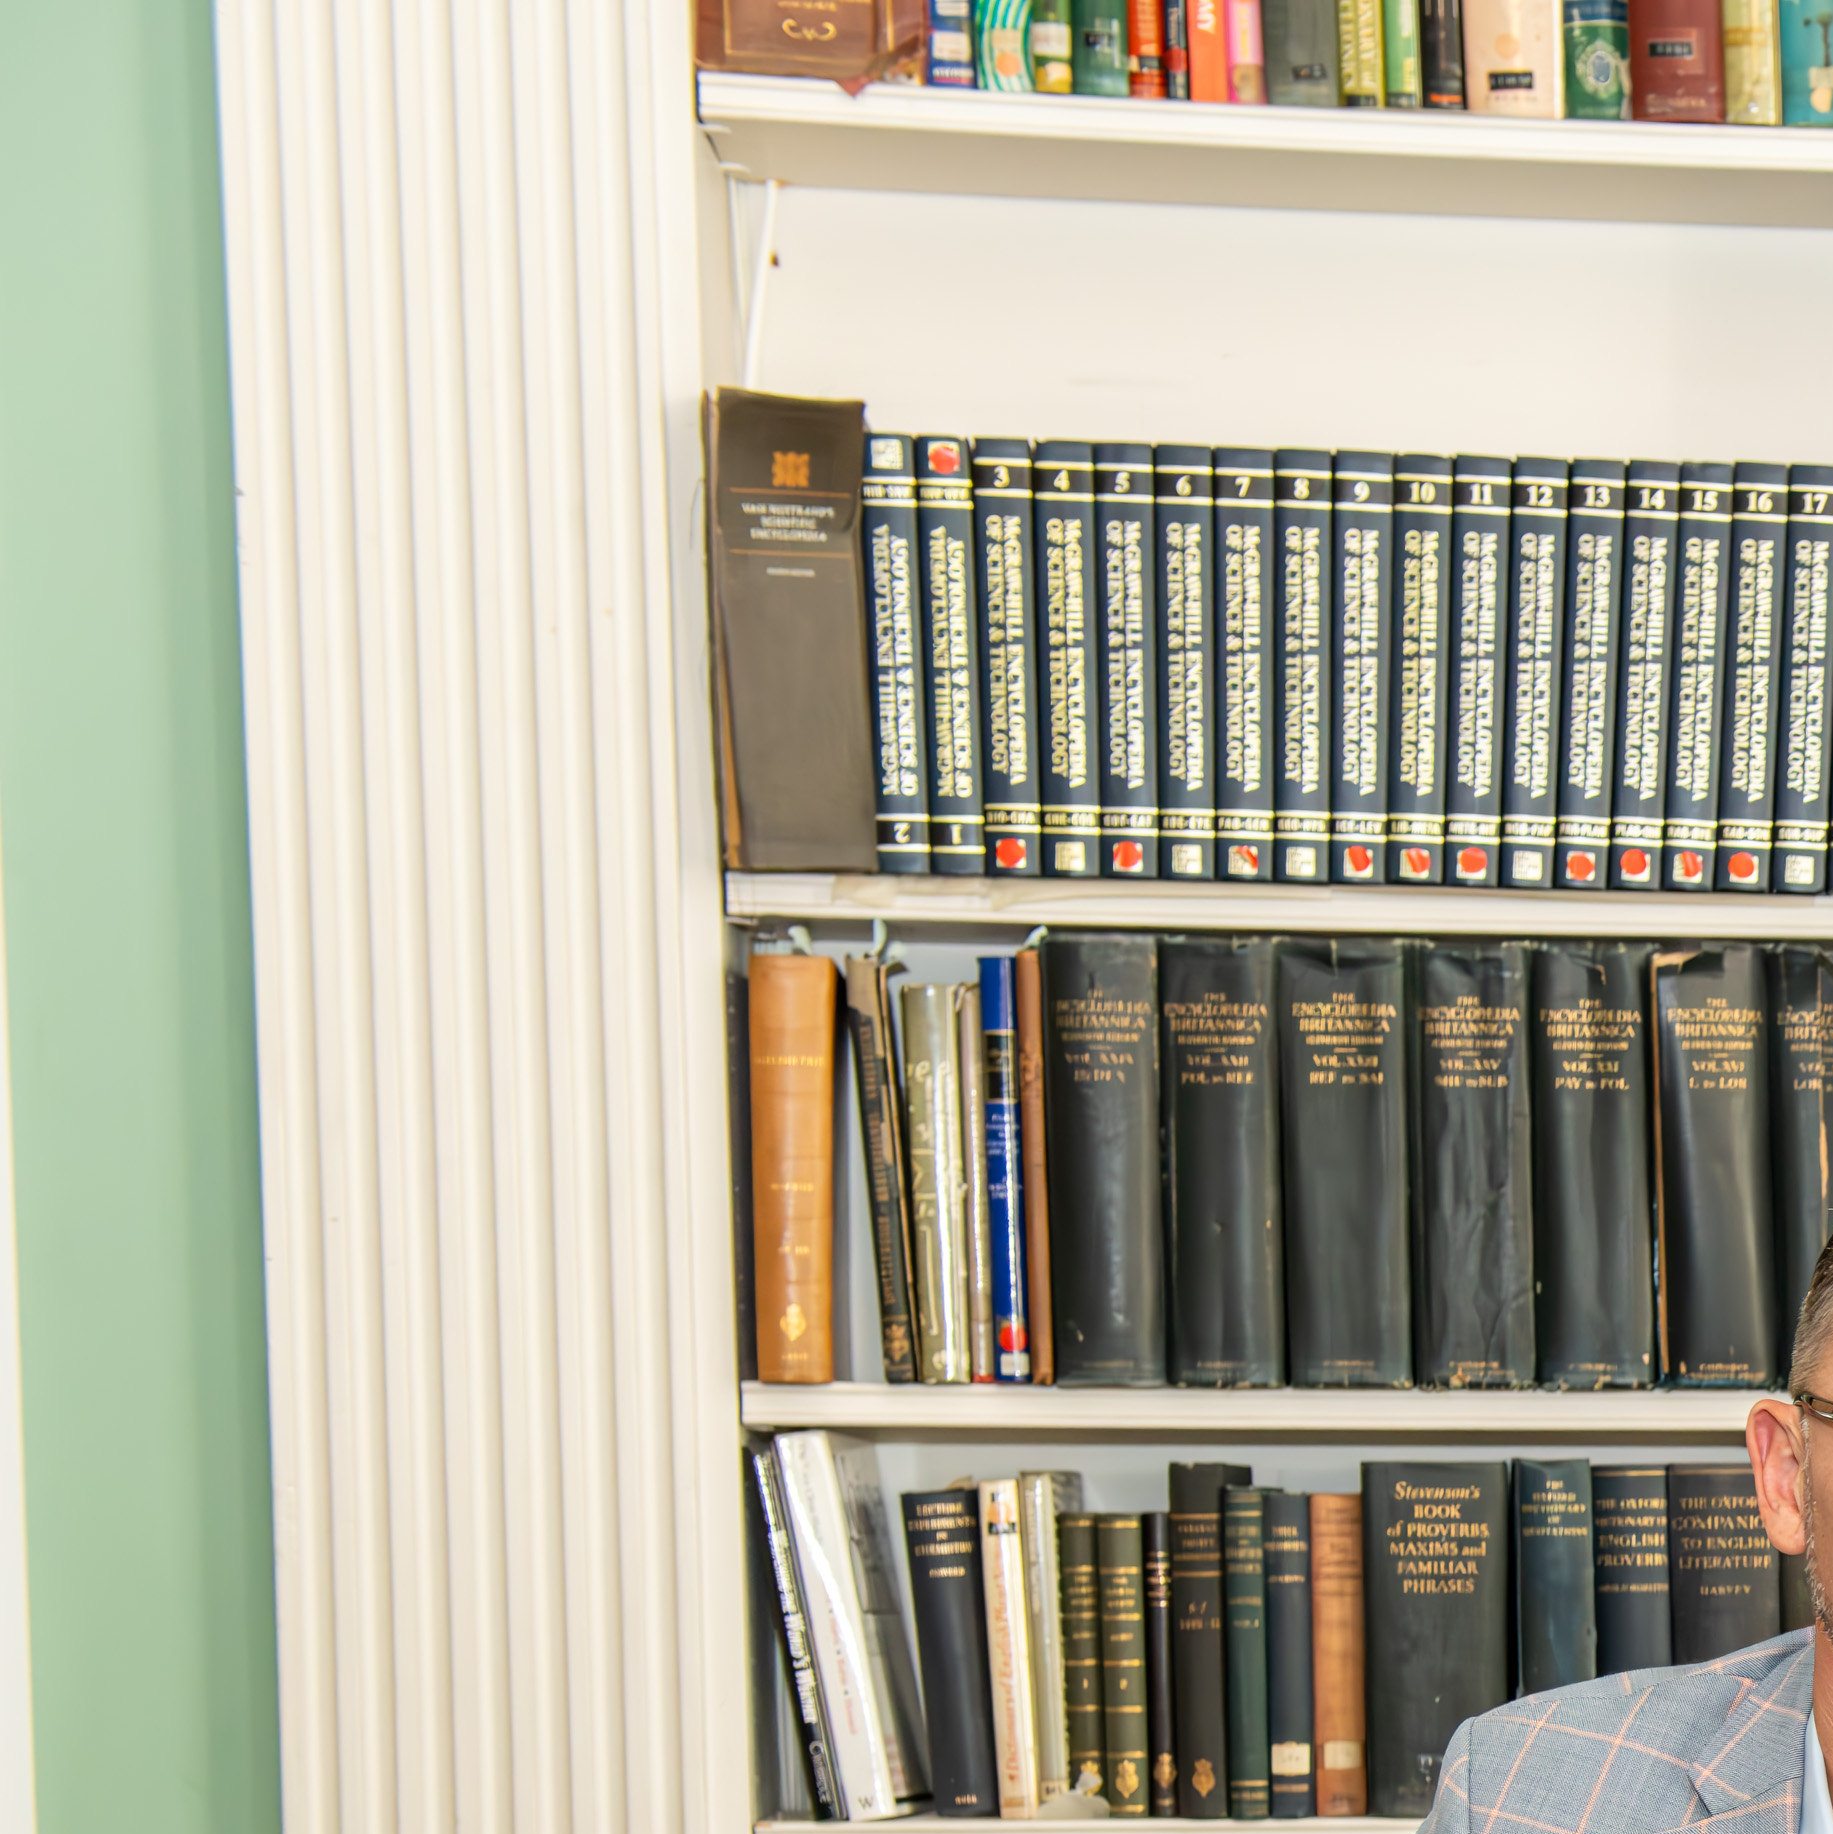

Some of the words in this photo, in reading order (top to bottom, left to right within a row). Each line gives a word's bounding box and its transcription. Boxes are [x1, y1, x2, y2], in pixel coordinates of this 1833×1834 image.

[993, 465, 1010, 488] 3
[1053, 469, 1070, 492] 4
[1113, 472, 1131, 494] 5
[1175, 475, 1191, 497] 6
[1235, 476, 1251, 498] 7
[1294, 477, 1310, 499] 8
[1354, 481, 1370, 502] 9
[1409, 482, 1436, 503] 10
[1469, 484, 1493, 504] 11
[1526, 486, 1553, 506] 12
[1584, 487, 1609, 507] 13
[1639, 488, 1666, 509] 14
[1692, 490, 1718, 510] 15
[1746, 491, 1773, 512] 16
[1800, 492, 1828, 514] 17
[986, 515, 1003, 542] OF
[986, 543, 1005, 624] SCIENCE
[947, 539, 968, 666] TECHNOLOGY
[988, 627, 1006, 642] &
[951, 669, 969, 685] &
[989, 644, 1009, 774] TECHNOLOGY
[952, 688, 972, 768] SCIENCE
[955, 771, 973, 797] OF
[894, 822, 911, 843] 2
[950, 823, 962, 844] 1
[1394, 1480, 1481, 1501] Stevenson's
[1413, 1503, 1462, 1520] BOOK
[1707, 1496, 1760, 1510] OXFOR
[1386, 1521, 1402, 1538] of
[1389, 1541, 1458, 1557] MAXIMS
[1461, 1541, 1486, 1557] and
[1598, 1533, 1666, 1549] ENGLISH
[1681, 1535, 1702, 1550] TO
[1397, 1559, 1479, 1576] FAMILIAR
[1678, 1553, 1772, 1570] LITERATURE
[1402, 1577, 1475, 1595] PHRASES
